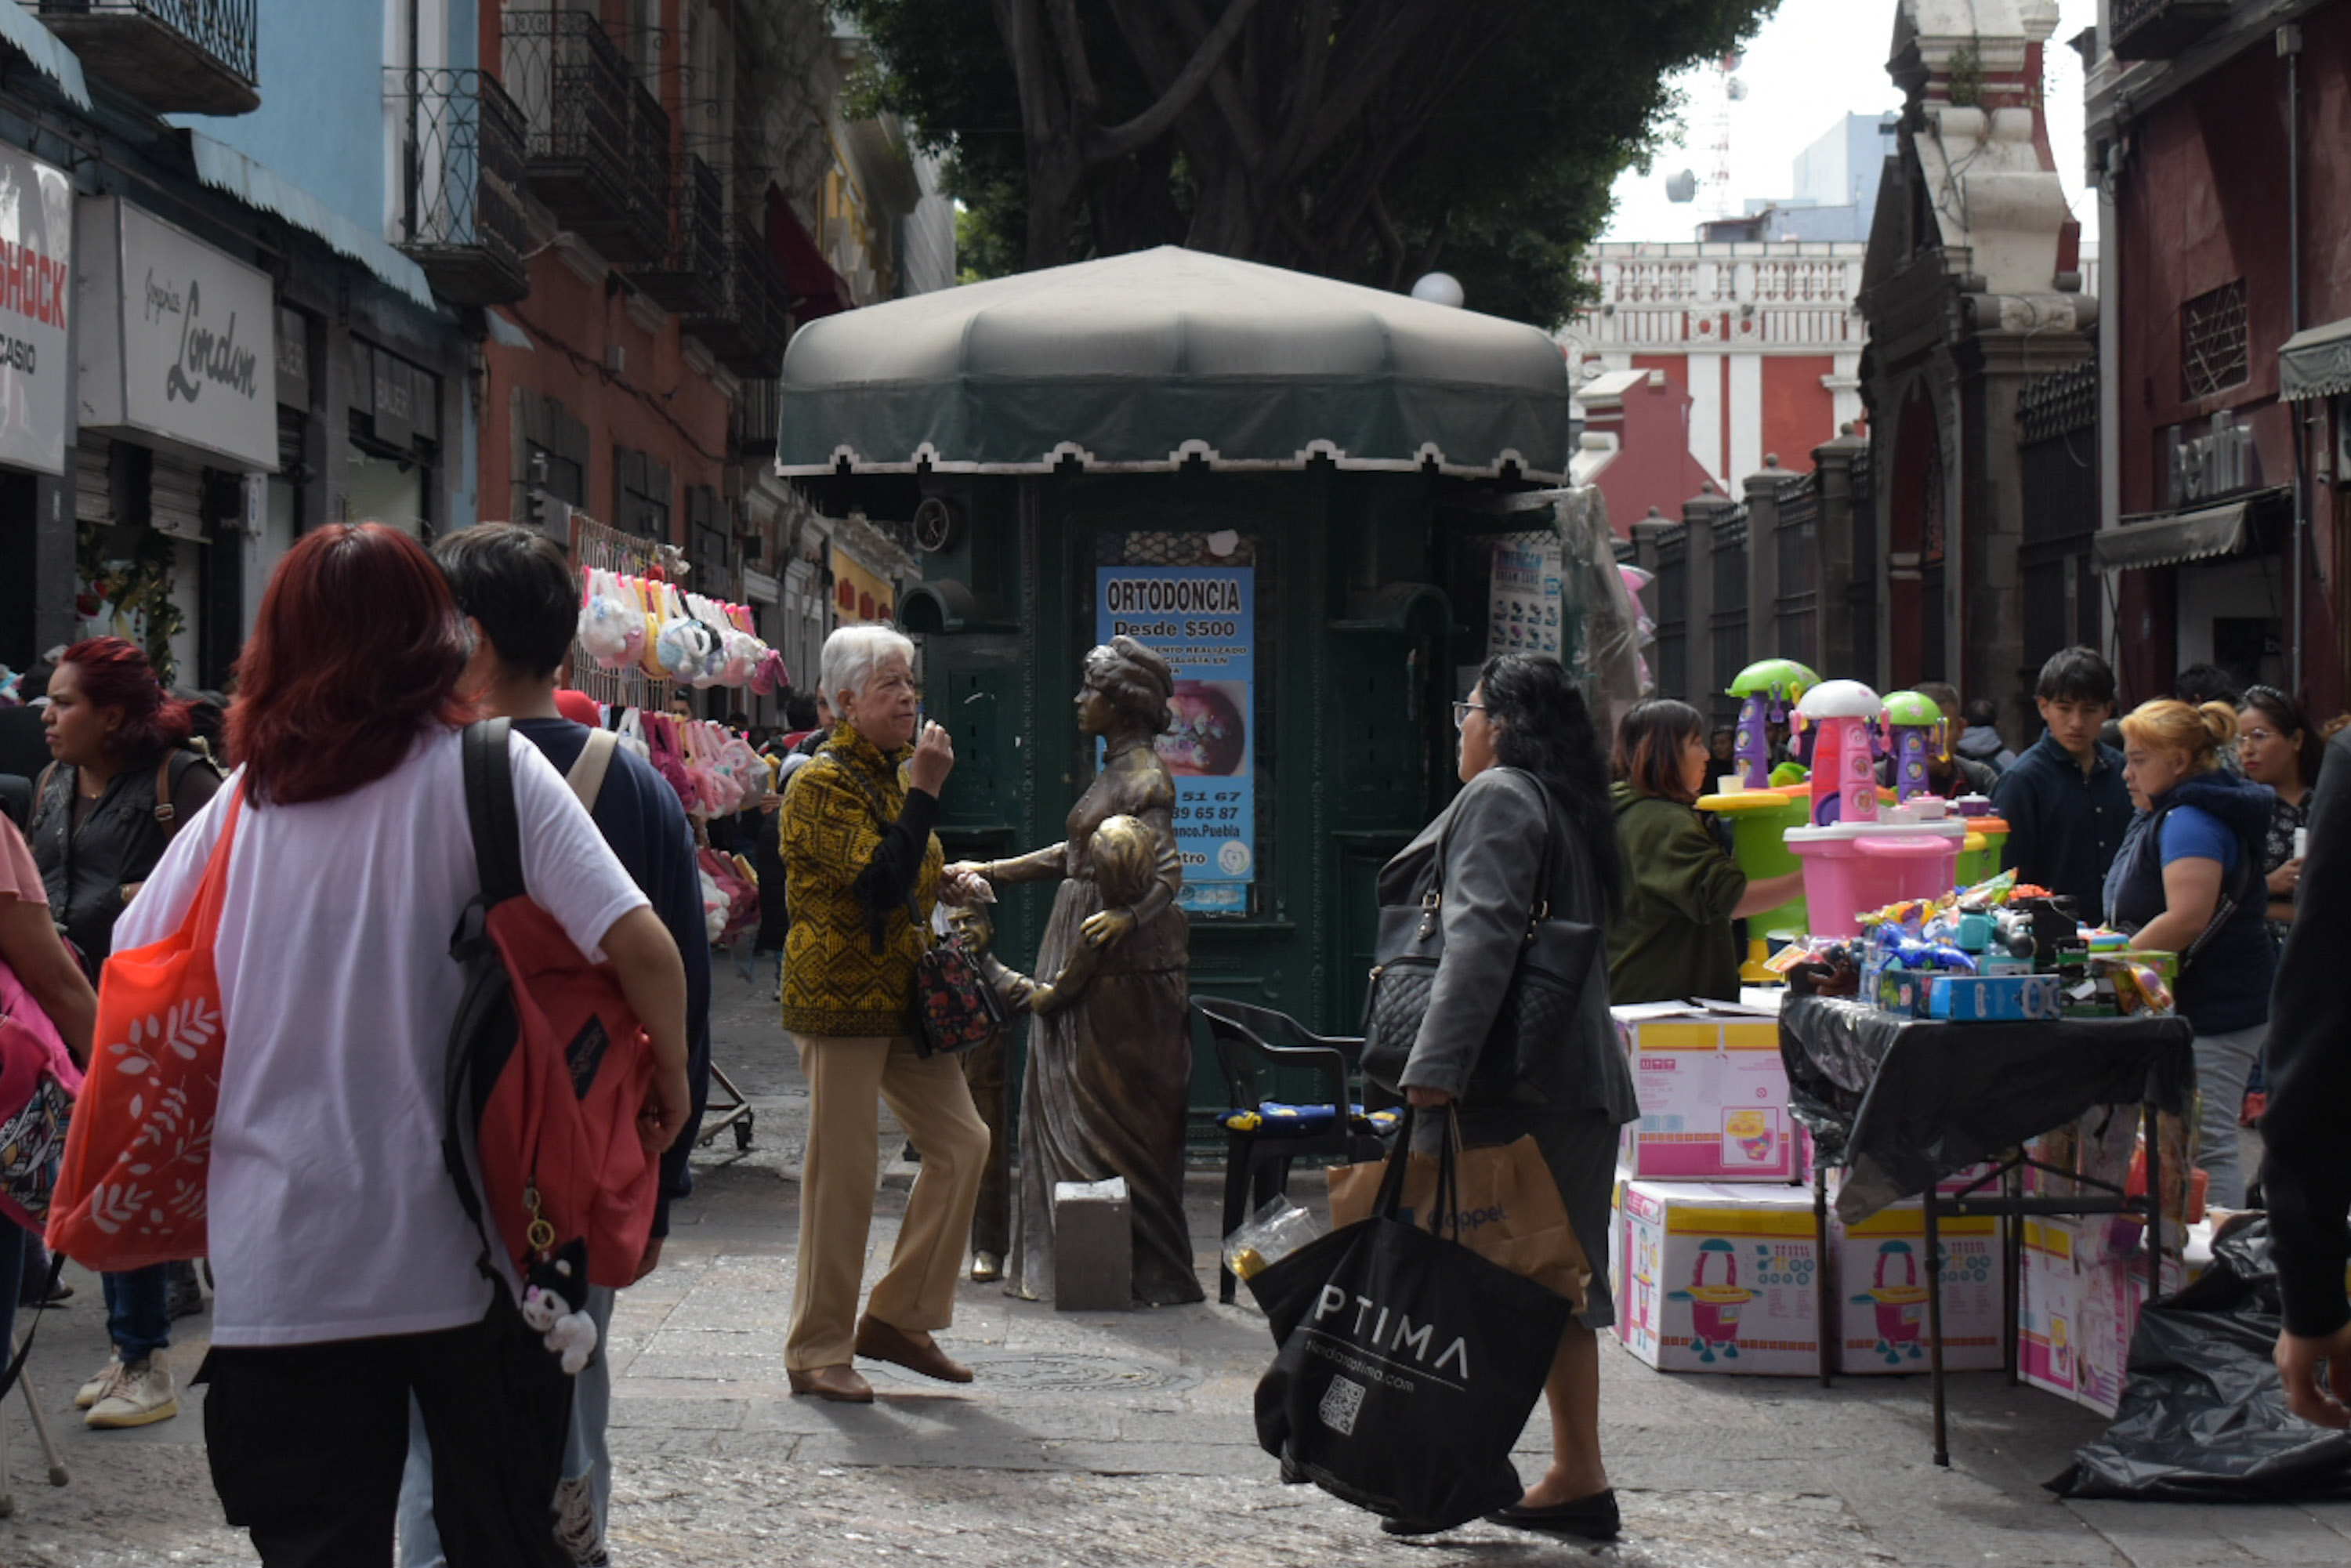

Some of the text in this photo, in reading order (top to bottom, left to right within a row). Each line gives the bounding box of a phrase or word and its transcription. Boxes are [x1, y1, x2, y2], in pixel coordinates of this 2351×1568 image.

[168, 280, 257, 404] London
[1107, 579, 1241, 613] ORTODONCIA
[1114, 620, 1236, 638] Desde $500
[1182, 791, 1241, 802] 51 67
[1194, 807, 1214, 820] 65
[1219, 807, 1239, 820] 87
